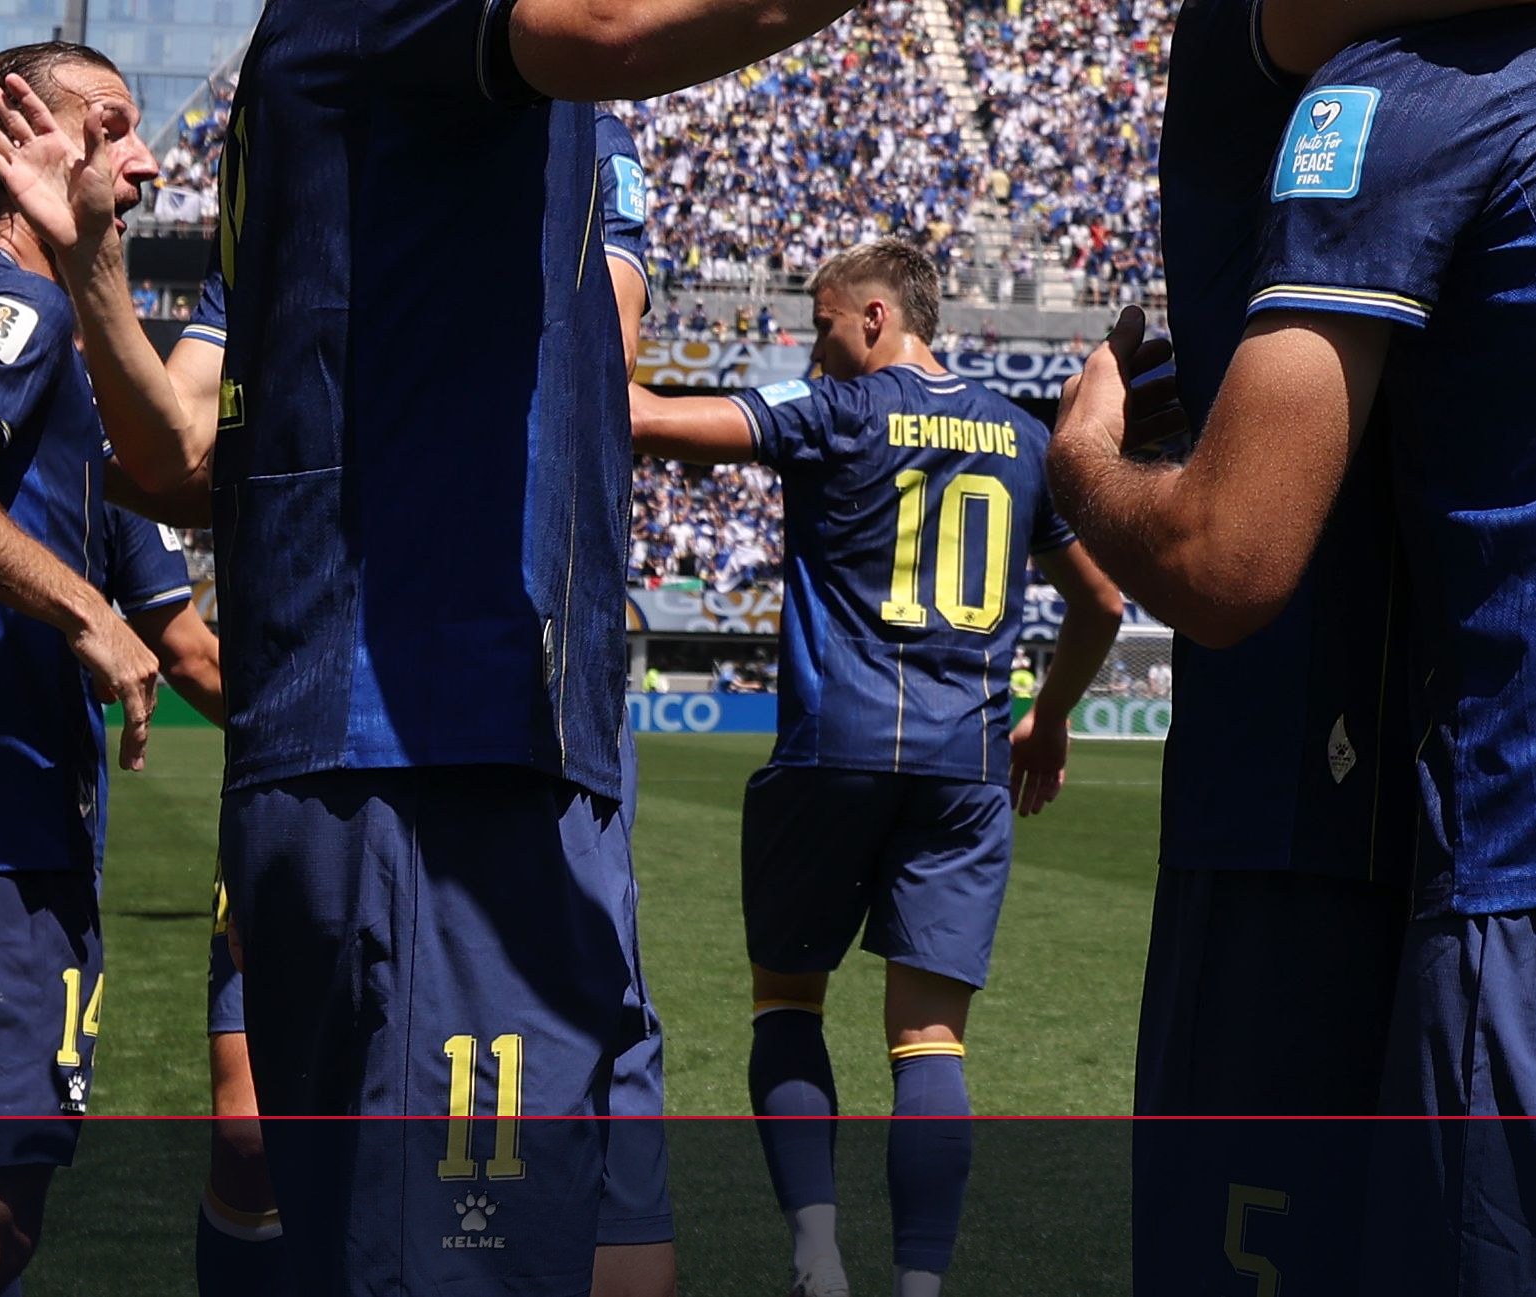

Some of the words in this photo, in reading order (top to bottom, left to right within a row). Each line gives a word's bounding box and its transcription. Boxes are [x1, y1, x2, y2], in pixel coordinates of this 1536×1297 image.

[1294, 134, 1322, 154] Unite
[1323, 131, 1342, 151] For
[1292, 152, 1336, 173] PEACE
[1296, 174, 1320, 184] FIFA
[946, 351, 1083, 381] GOA
[888, 413, 1017, 458] DEMIROVIĆ
[881, 469, 1012, 634] 10
[655, 589, 782, 616] GOA
[438, 1034, 525, 1181] 11
[442, 1236, 505, 1248] KELME
